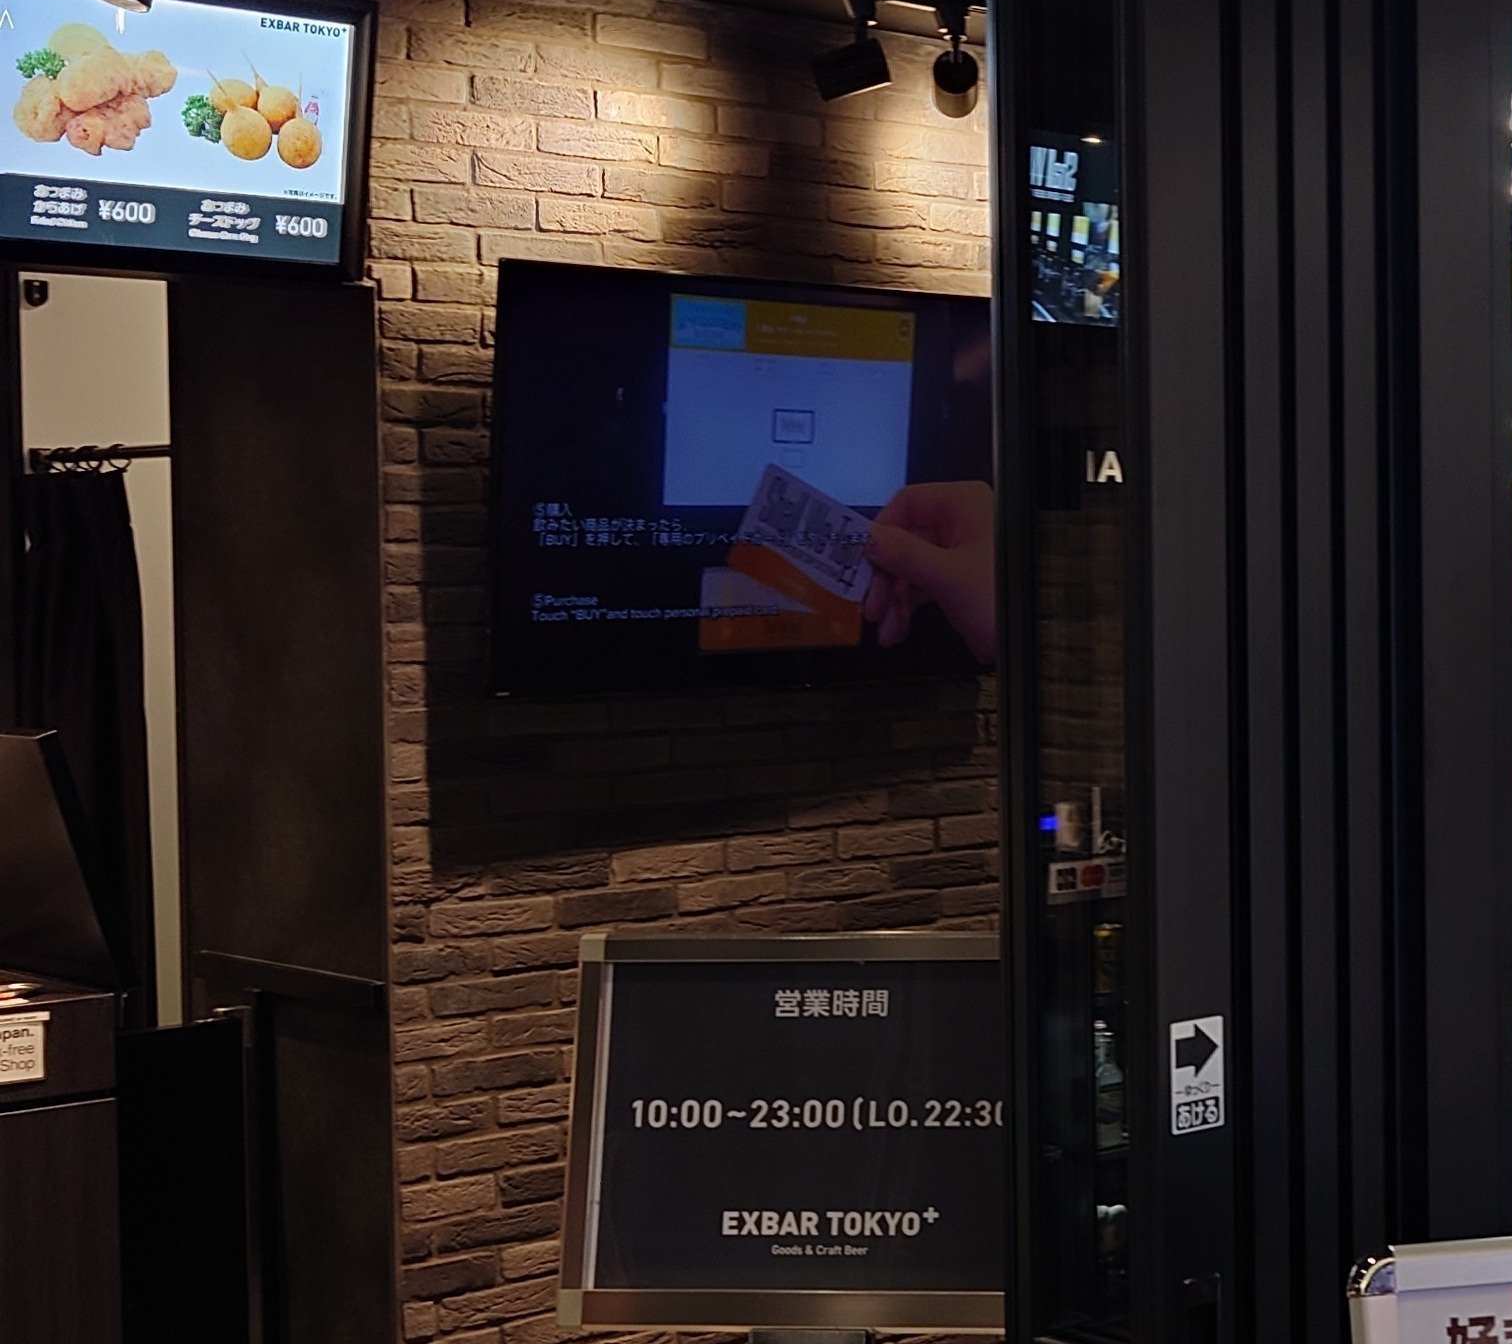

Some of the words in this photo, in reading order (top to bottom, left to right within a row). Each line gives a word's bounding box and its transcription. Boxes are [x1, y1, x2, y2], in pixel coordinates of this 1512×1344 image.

[260, 17, 300, 32] EXBAR
[98, 199, 156, 224] ¥600
[275, 214, 328, 239] ¥600
[774, 989, 890, 1018] 営業時間
[0, 1028, 34, 1042] pan.
[0, 1044, 35, 1057] -free
[1177, 1099, 1219, 1129] あける
[721, 1210, 819, 1237] EXBAR
[771, 1244, 802, 1256] Goods
[805, 1244, 814, 1256] &
[815, 1244, 842, 1256] Craft
[844, 1244, 868, 1256] Beer
